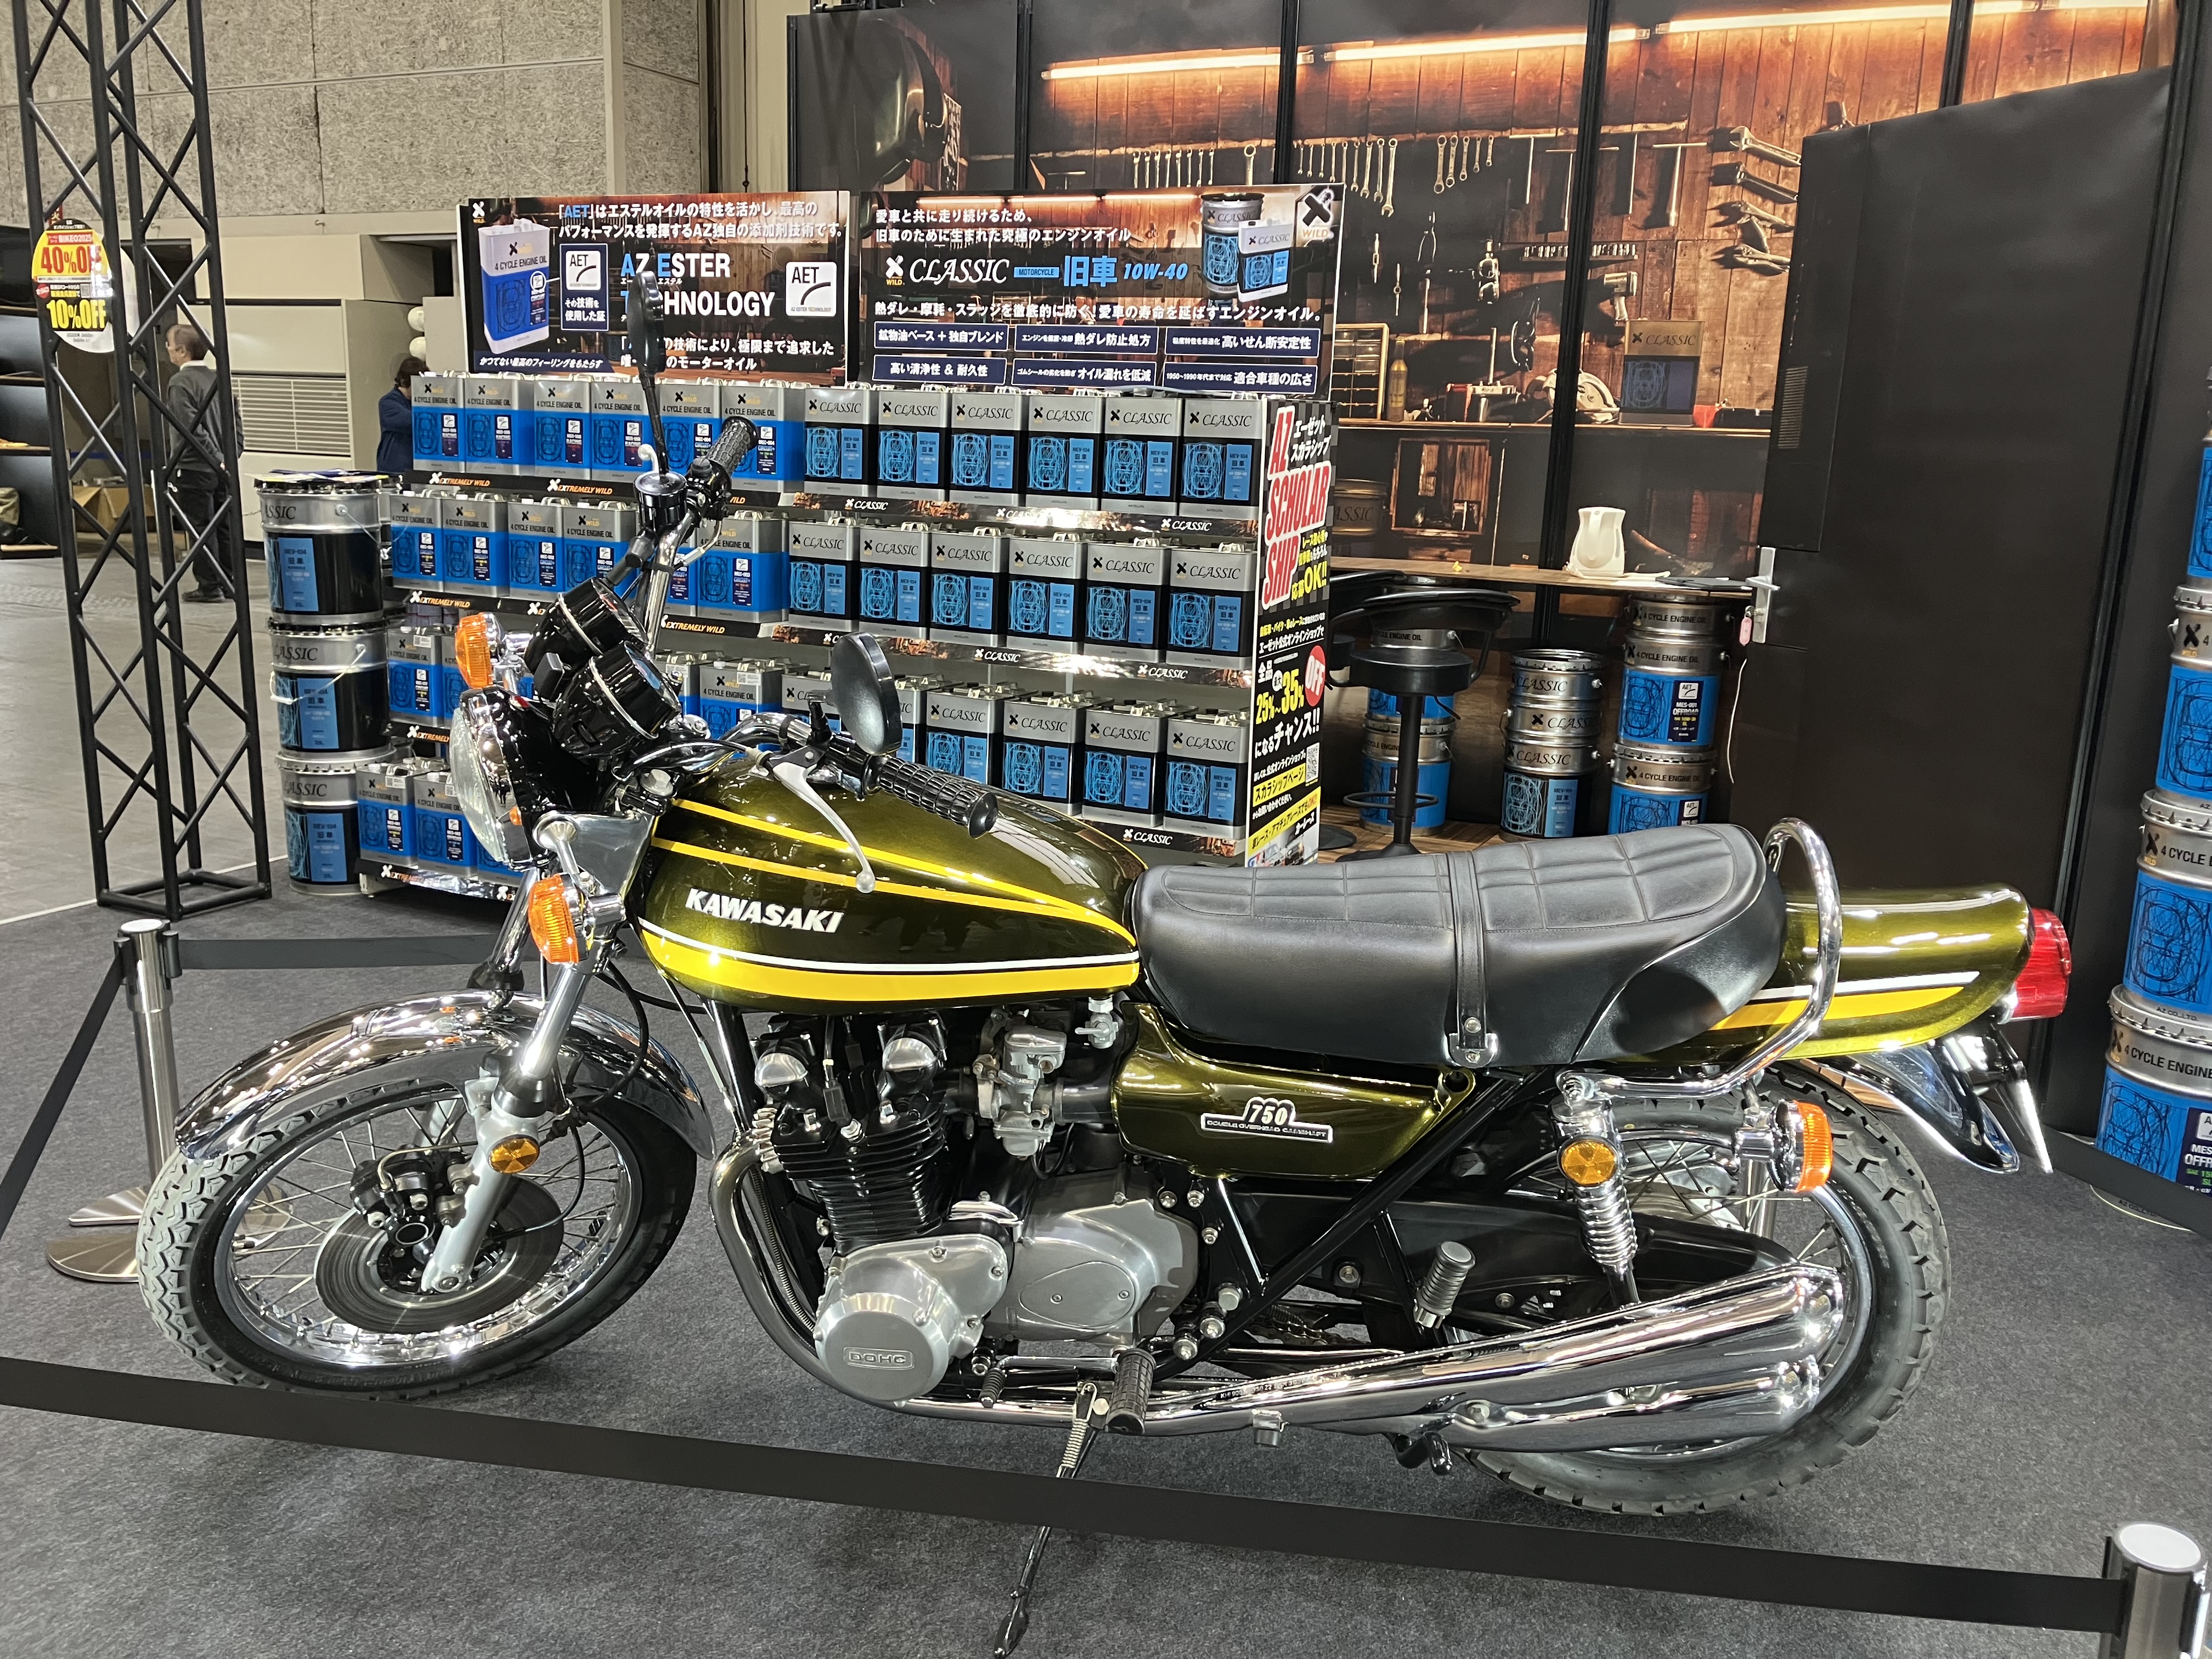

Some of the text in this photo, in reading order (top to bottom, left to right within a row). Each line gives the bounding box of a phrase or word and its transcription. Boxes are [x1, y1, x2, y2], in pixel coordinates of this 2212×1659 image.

[876, 209, 1032, 223] 愛車と共に走り続けるため、
[876, 228, 1131, 242] 旧車のために生まれた究極のエンジンオイル
[1258, 234, 1290, 245] CLASSIC
[1302, 228, 1328, 237] WILD
[500, 259, 517, 269] CYCLE
[519, 256, 538, 268] ENGINE
[570, 255, 588, 266] AET
[620, 253, 730, 277] AZ ESTER
[792, 267, 819, 284] AET
[910, 258, 1009, 285] CLASSIC
[1064, 255, 1118, 287] 旧車
[1123, 263, 1188, 280] 10W-40
[565, 297, 599, 309] その技術を
[620, 291, 775, 317] THNOLOGY
[46, 300, 106, 329] 10%OFF
[565, 310, 606, 323] 使用した証
[878, 329, 934, 342] 鉱物油ベース
[949, 330, 1004, 344] 独自ブレンド
[1074, 332, 1151, 347] 熱ダレ防止処方
[1221, 335, 1312, 351] 高いせん断安定性
[1646, 333, 1697, 346] CLASSIC
[479, 357, 603, 370] かつてない最高のフィーリングをもたらす
[890, 362, 988, 377] 高い清浄性 & 耐久性
[1077, 368, 1151, 383] オイル漏れを低減
[1233, 371, 1313, 386] 適合車種の広さ
[820, 402, 861, 414] CLASSIC
[894, 404, 938, 416] CLASSIC
[968, 407, 1013, 419] CLASSIC
[1046, 410, 1093, 422] CLASSIC
[1124, 412, 1172, 424] CLASSIC
[1203, 414, 1251, 427] CLASSIC
[1294, 415, 1326, 438] エーゼット
[1270, 410, 1293, 476] AZ
[1291, 435, 1333, 463] スカラシップ
[440, 478, 474, 486] EXTREMELY
[557, 484, 594, 494] EXTREMELY
[854, 500, 889, 510] CLASSIC
[1267, 465, 1330, 541] SCHOLAR
[1172, 520, 1212, 532] CLASSIC
[803, 537, 844, 550] CLASSIC
[876, 543, 919, 556] CLASSIC
[948, 548, 992, 562] CLASSIC
[1027, 554, 1073, 568] CLASSIC
[1106, 560, 1155, 574] CLASSIC
[1190, 566, 1241, 579] CLASSIC
[1264, 535, 1299, 605] SHIP
[420, 596, 470, 608] EXTREMELY WILD
[665, 622, 725, 634] EXTREMELY WILD
[984, 651, 1021, 663] CLASSIC
[1148, 668, 1188, 679] CLASSIC
[1257, 659, 1273, 684] 全品
[1305, 653, 1325, 696] OFF
[1516, 676, 1567, 692] CLASSIC
[708, 688, 724, 697] CYCLE
[726, 690, 744, 699] ENGINE
[746, 692, 755, 700] OIL
[942, 708, 985, 723] CLASSIC
[1021, 718, 1068, 732] CLASSIC
[416, 732, 449, 743] EXTREMELY
[1103, 726, 1150, 741] CLASSIC
[1186, 736, 1235, 752] CLASSIC
[1517, 750, 1571, 765] CLASSIC
[1255, 765, 1305, 803] スカラシップページ
[1133, 831, 1173, 845] CLASSIC
[2161, 845, 2206, 865] 4 CYCLE
[685, 888, 845, 933] KAWASAKI
[2124, 1045, 2130, 1054] 4
[2131, 1047, 2165, 1068] CYCLE
[1248, 1104, 1288, 1125] 750
[849, 1352, 906, 1364] DOHC
